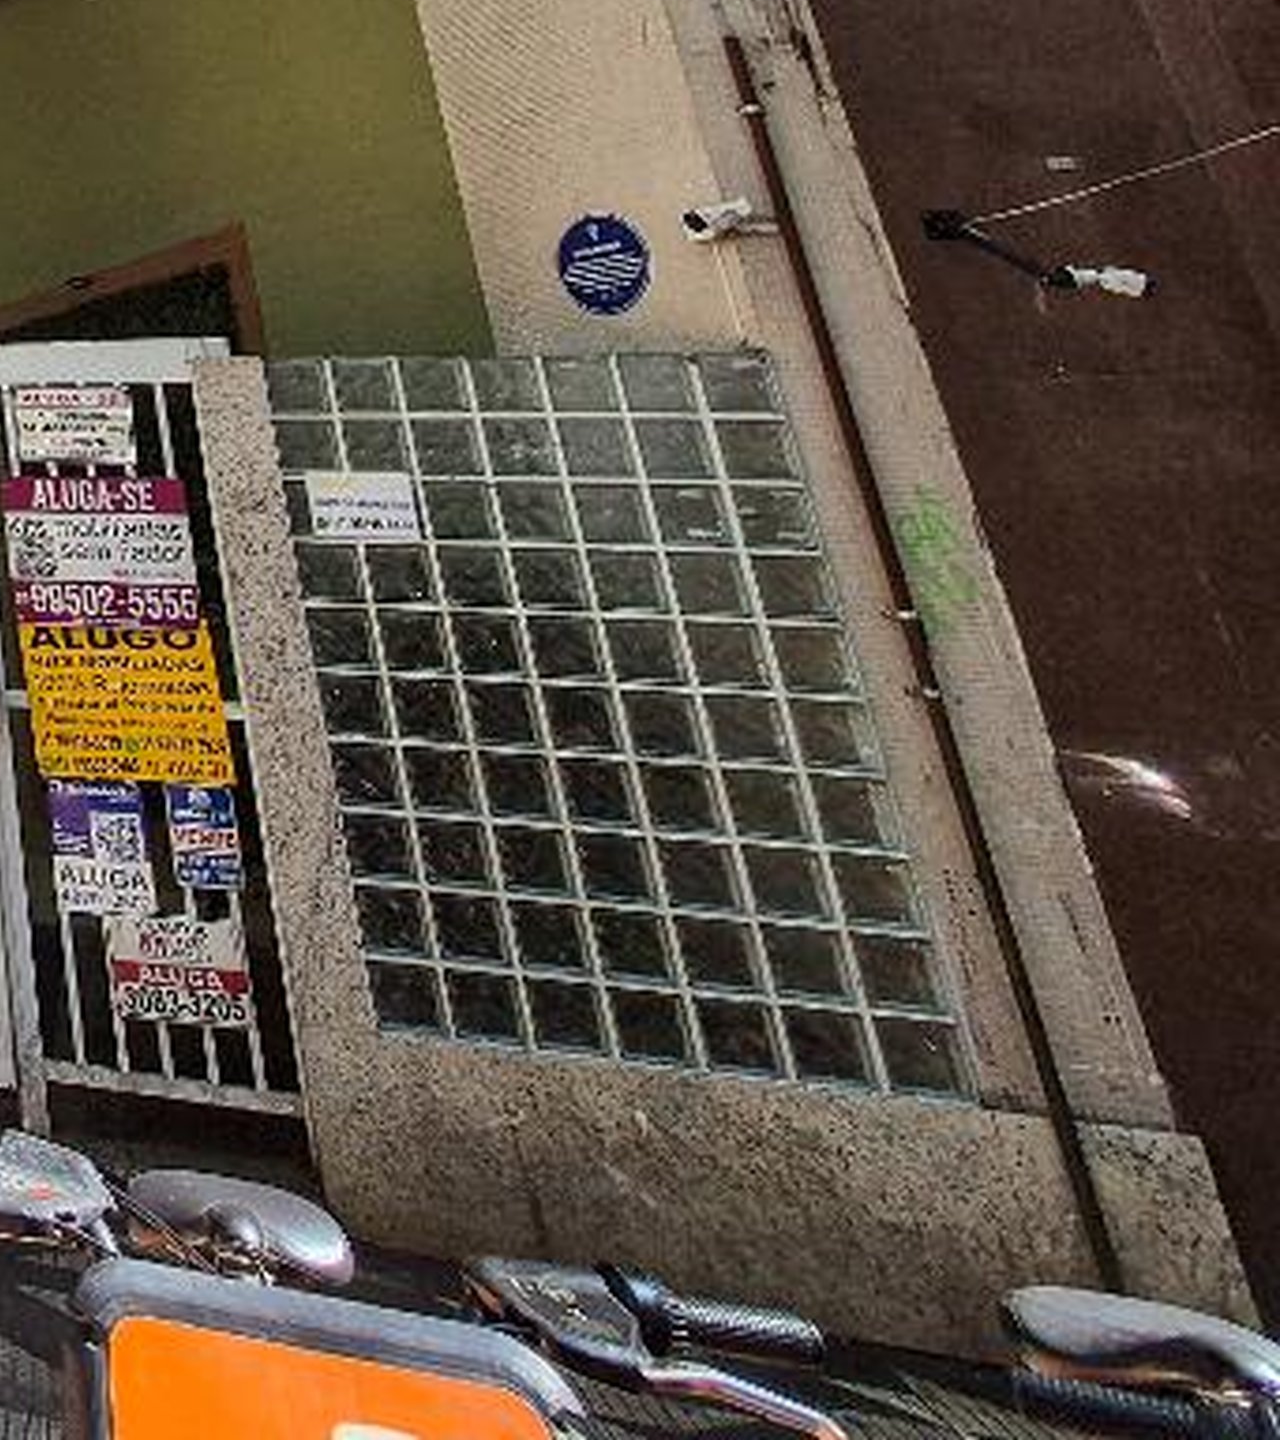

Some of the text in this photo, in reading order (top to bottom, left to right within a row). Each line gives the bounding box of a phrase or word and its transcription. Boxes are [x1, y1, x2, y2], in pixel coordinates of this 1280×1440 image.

[31, 479, 157, 512] ALUGA-SE
[30, 629, 199, 651] ALUGO
[59, 864, 151, 892] ALUGA
